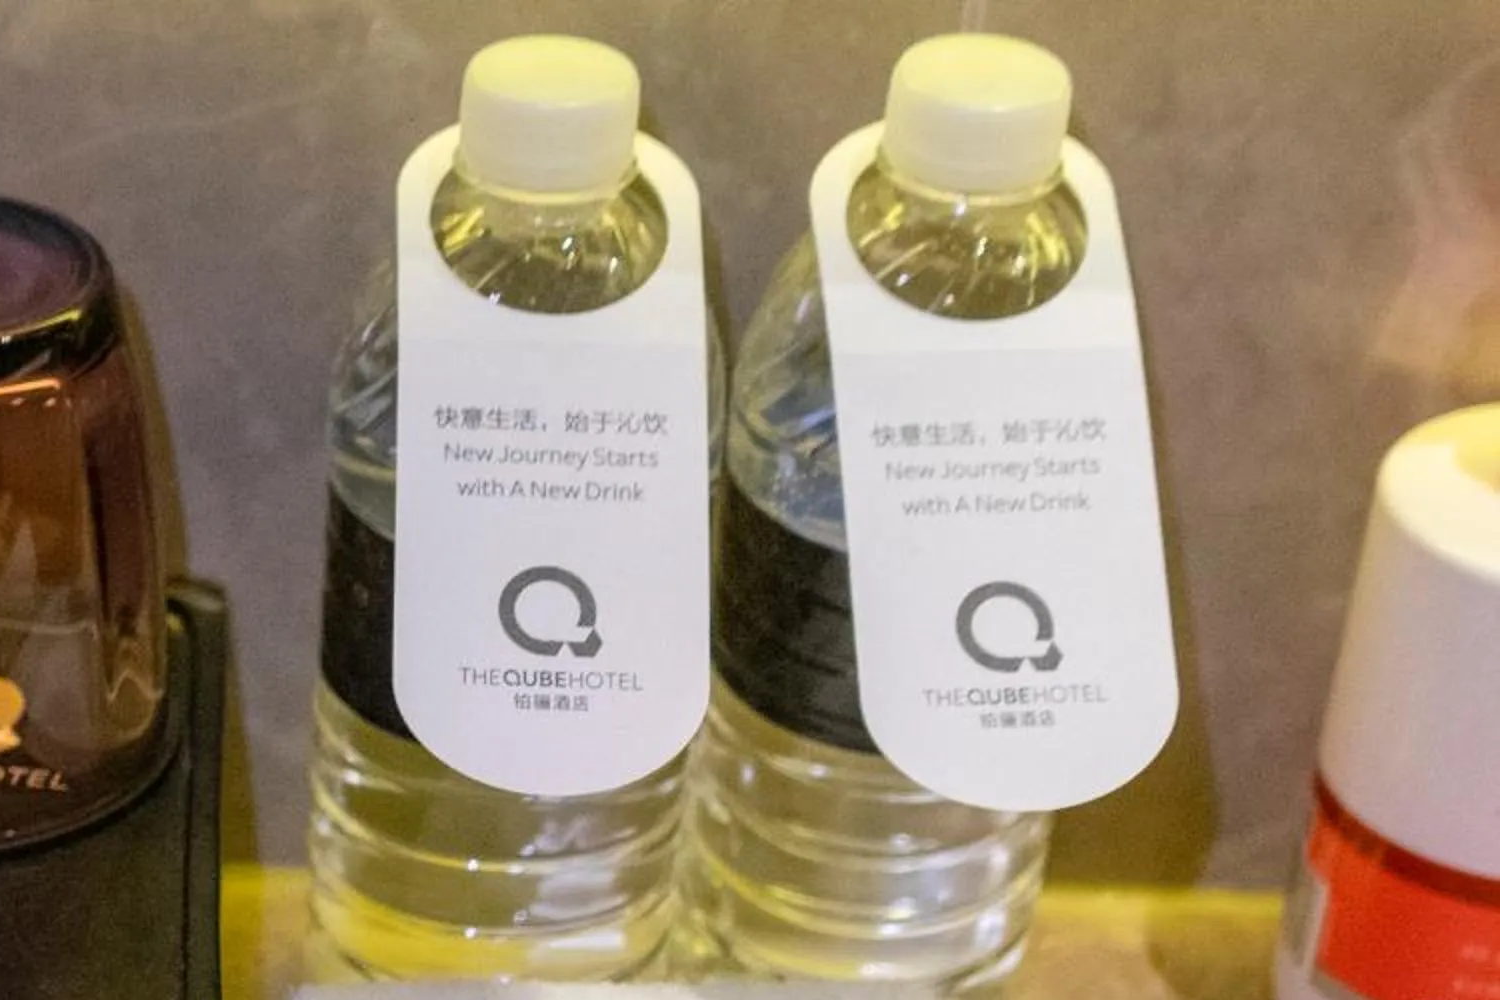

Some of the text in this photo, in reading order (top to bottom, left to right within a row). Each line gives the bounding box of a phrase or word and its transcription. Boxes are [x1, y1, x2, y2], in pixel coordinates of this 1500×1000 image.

[443, 444, 659, 471] New Journey Starts
[885, 457, 1101, 483] New Journey Starts
[457, 478, 645, 501] with A New Drink
[902, 491, 1092, 516] with A New Drink
